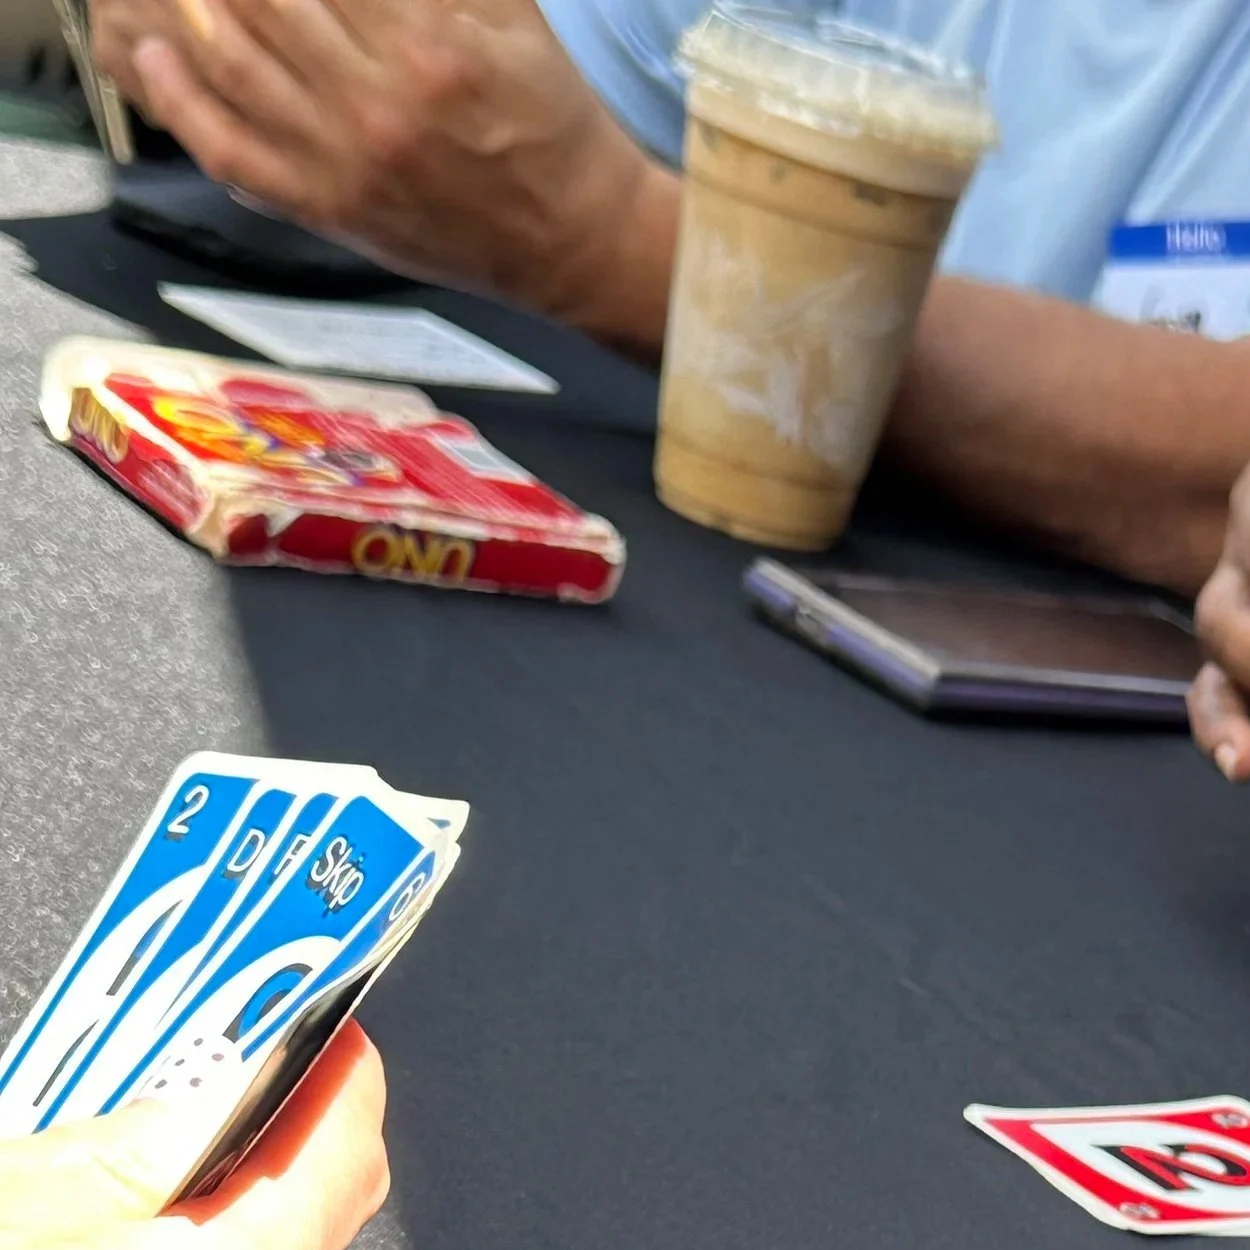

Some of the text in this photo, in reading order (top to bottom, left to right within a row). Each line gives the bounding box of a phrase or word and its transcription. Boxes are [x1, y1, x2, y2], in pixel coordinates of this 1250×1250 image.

[352, 528, 475, 584] UNO
[167, 784, 210, 834] 2
[310, 836, 366, 909] Skip
